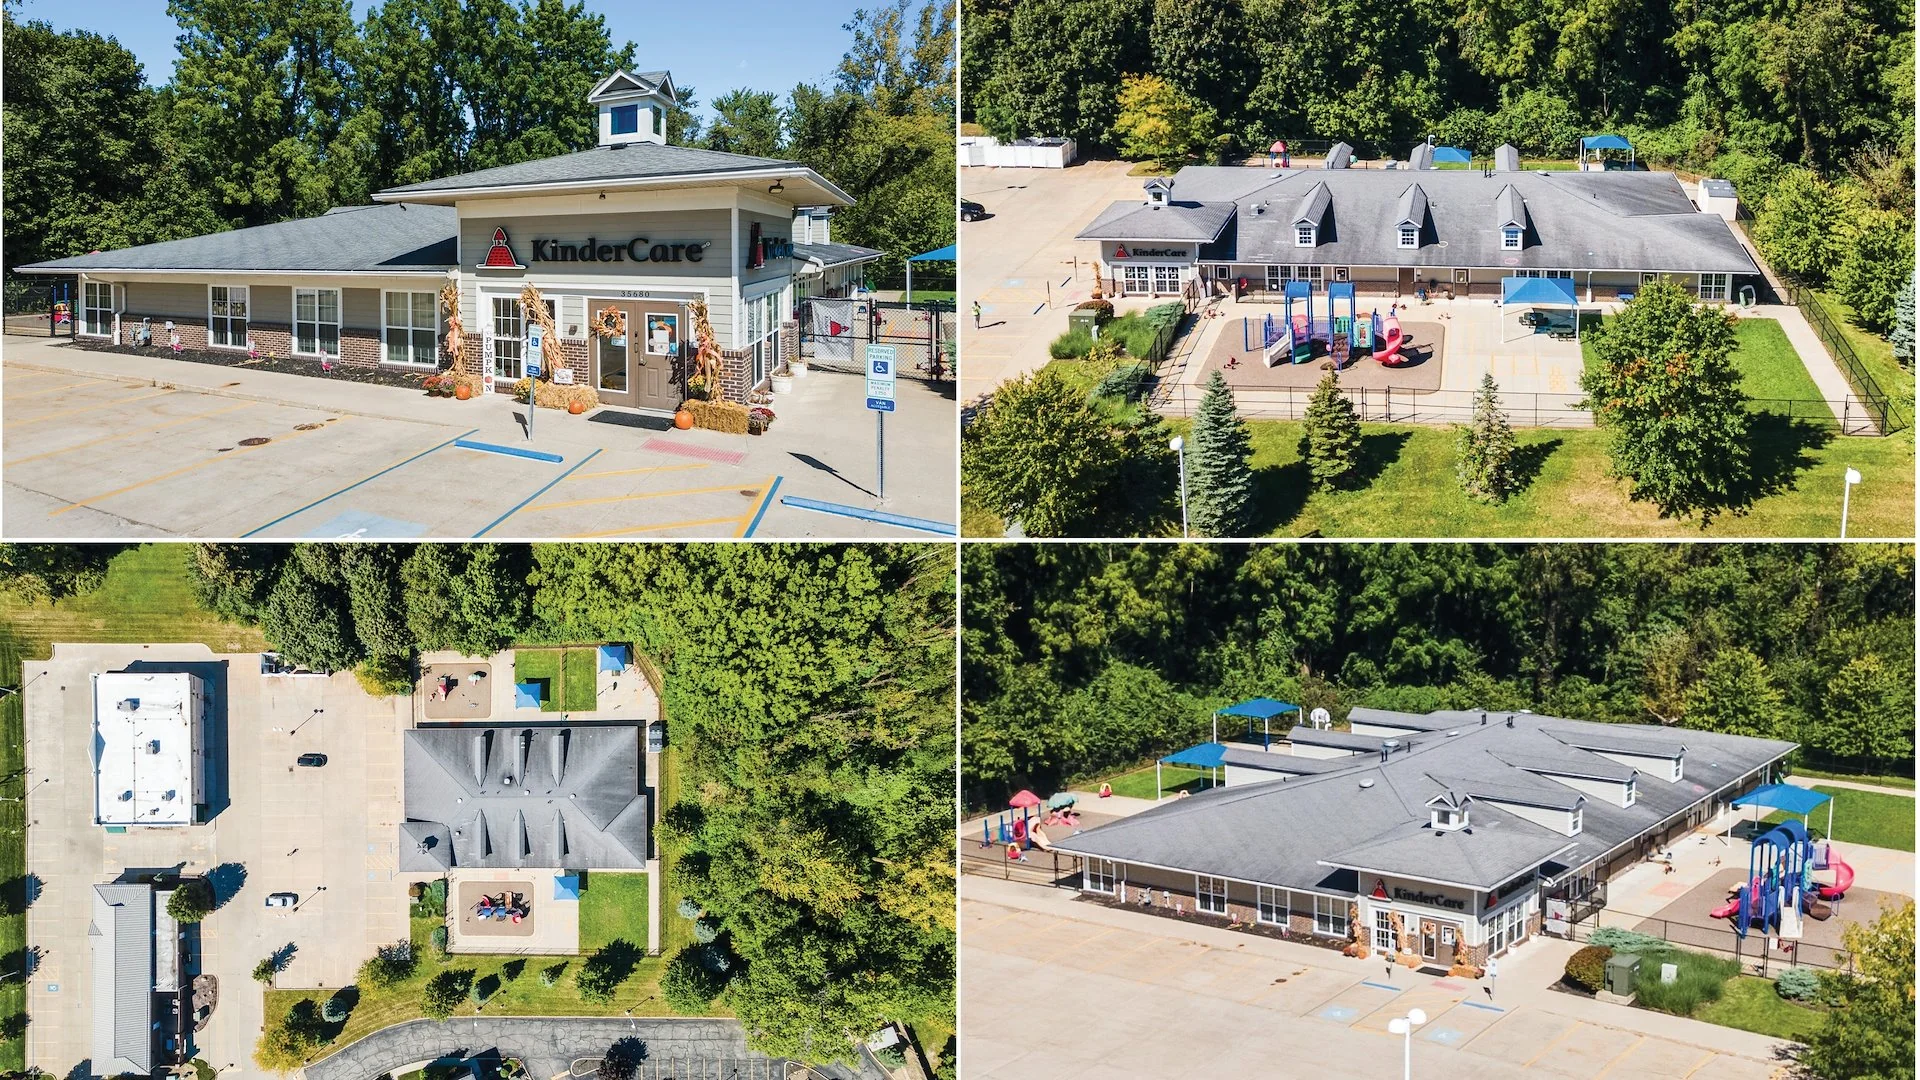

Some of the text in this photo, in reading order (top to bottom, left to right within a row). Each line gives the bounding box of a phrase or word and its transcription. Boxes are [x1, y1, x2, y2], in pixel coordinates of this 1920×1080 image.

[531, 237, 704, 263] KinderCare
[1132, 248, 1187, 257] KinderCare
[484, 336, 493, 392] PUMPKN
[1394, 887, 1465, 910] KinderCare
